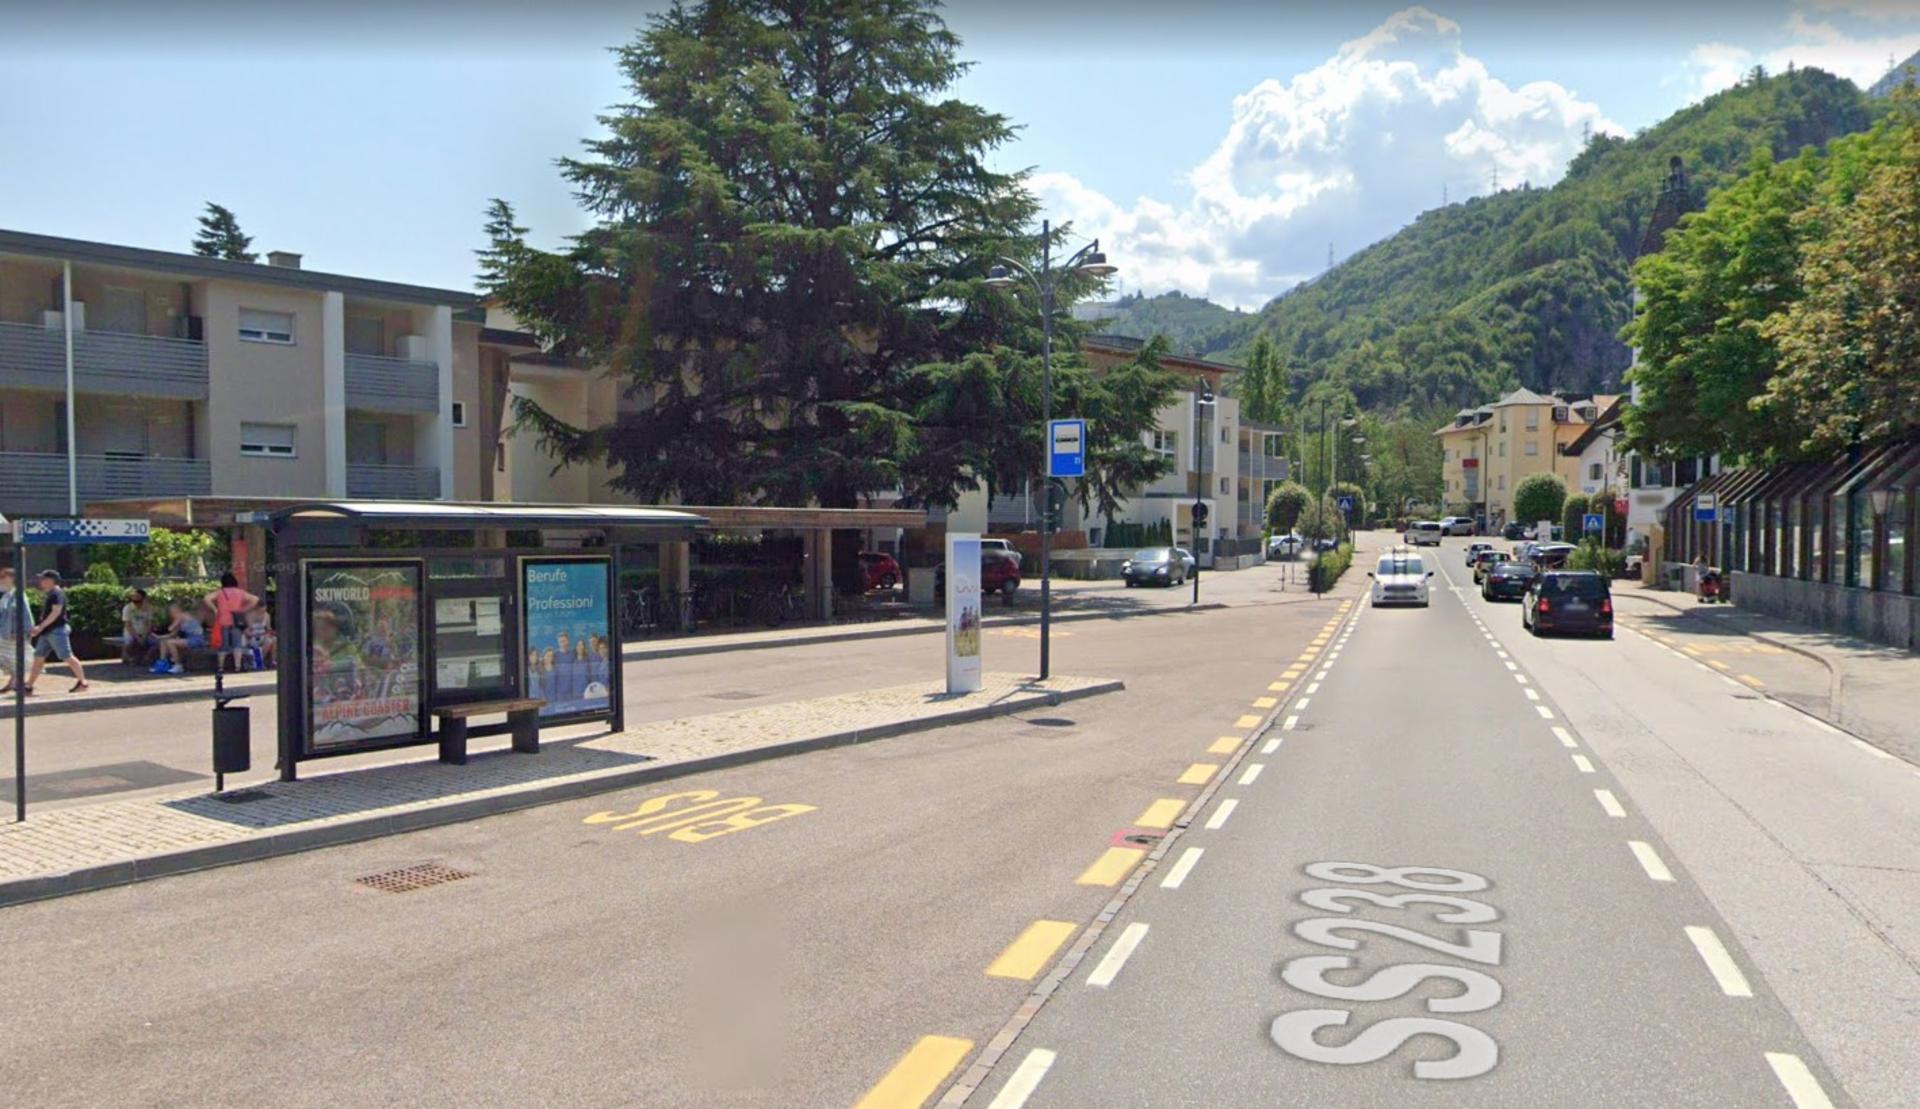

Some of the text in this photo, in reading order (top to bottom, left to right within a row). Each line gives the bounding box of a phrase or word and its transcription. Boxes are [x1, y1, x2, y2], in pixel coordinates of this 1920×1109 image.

[124, 522, 148, 535] 210
[527, 568, 567, 583] Berufe
[315, 586, 370, 602] SKIWORLD
[528, 595, 594, 610] Professioni
[322, 698, 410, 720] ALPINE COASTER
[582, 790, 819, 843] BUS
[1270, 861, 1502, 1079] SS238
